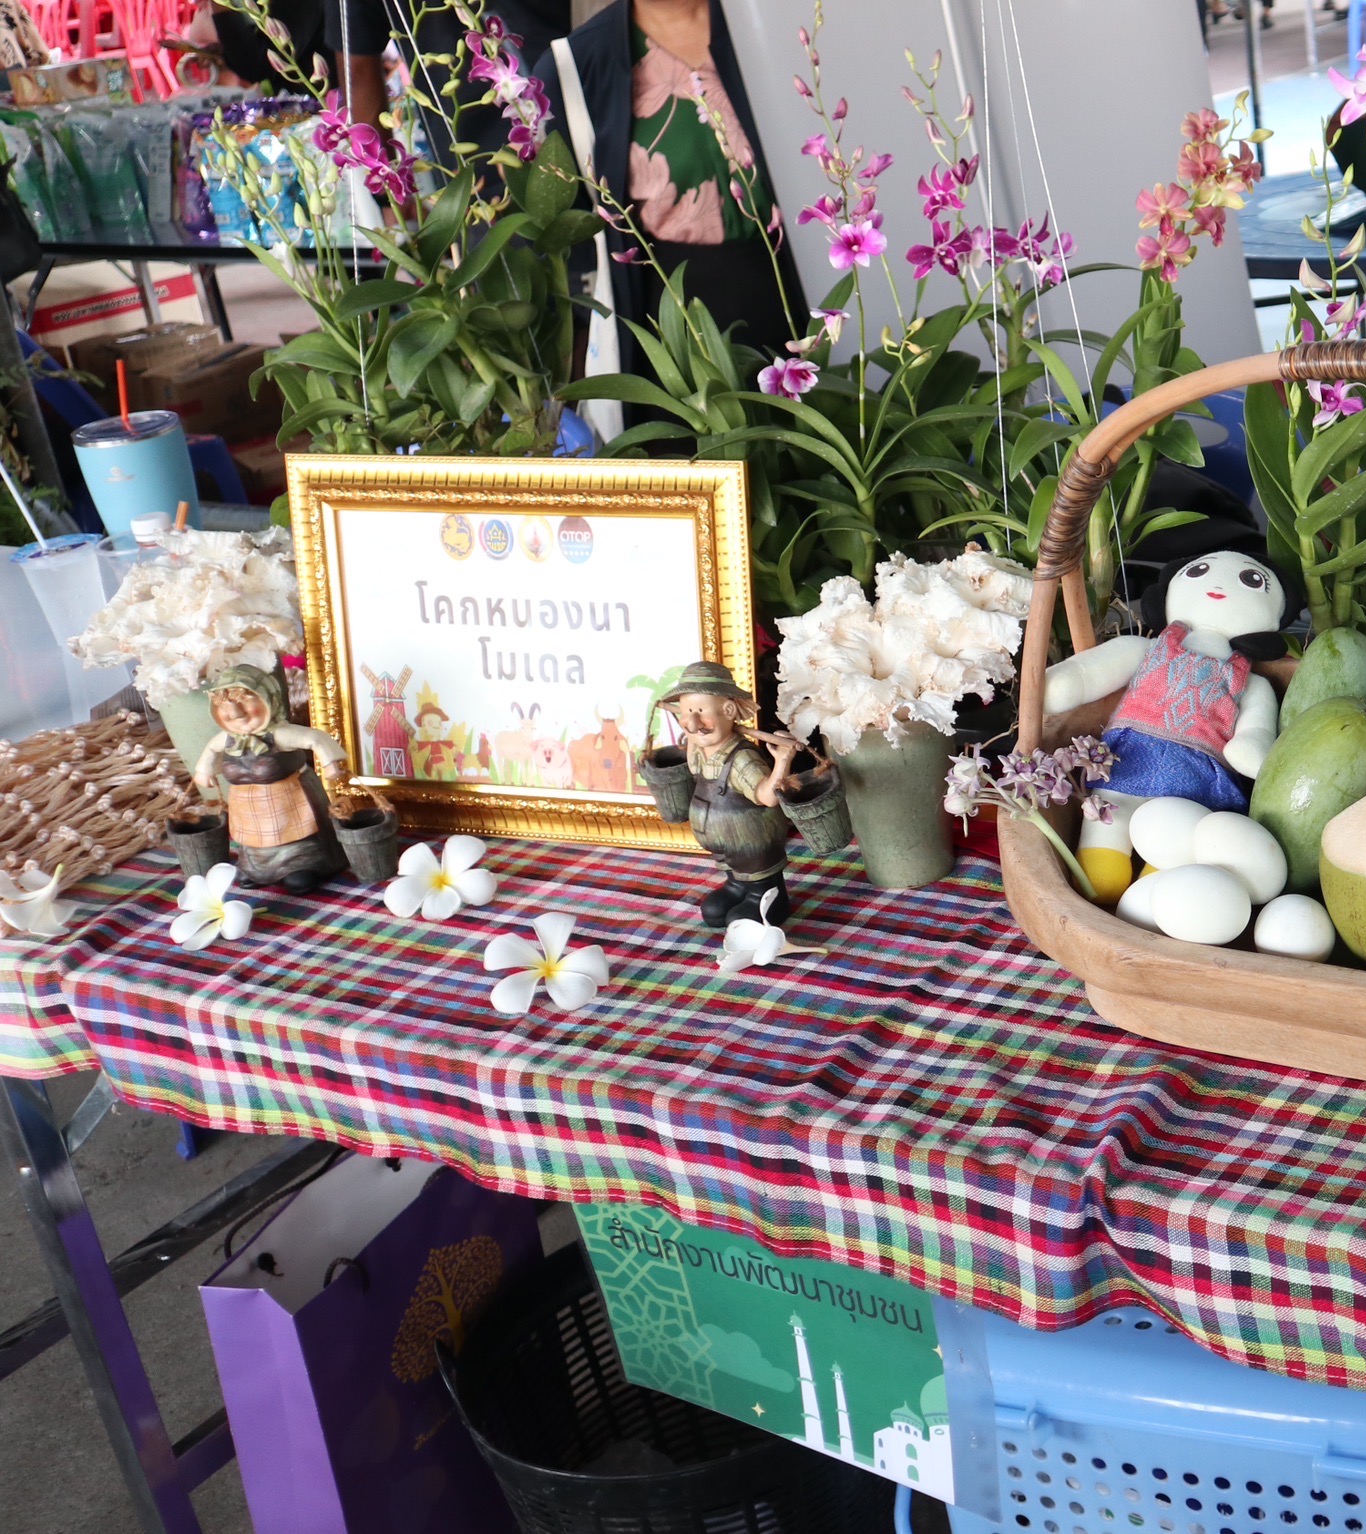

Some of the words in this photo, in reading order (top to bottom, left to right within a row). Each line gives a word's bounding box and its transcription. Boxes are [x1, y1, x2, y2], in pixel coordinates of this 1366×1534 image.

[560, 530, 591, 542] OTOP
[415, 580, 631, 632] โคกหนองนา
[478, 636, 585, 684] โมเดล
[607, 1217, 924, 1334] สำนักงานพัฒนาชุมชน
